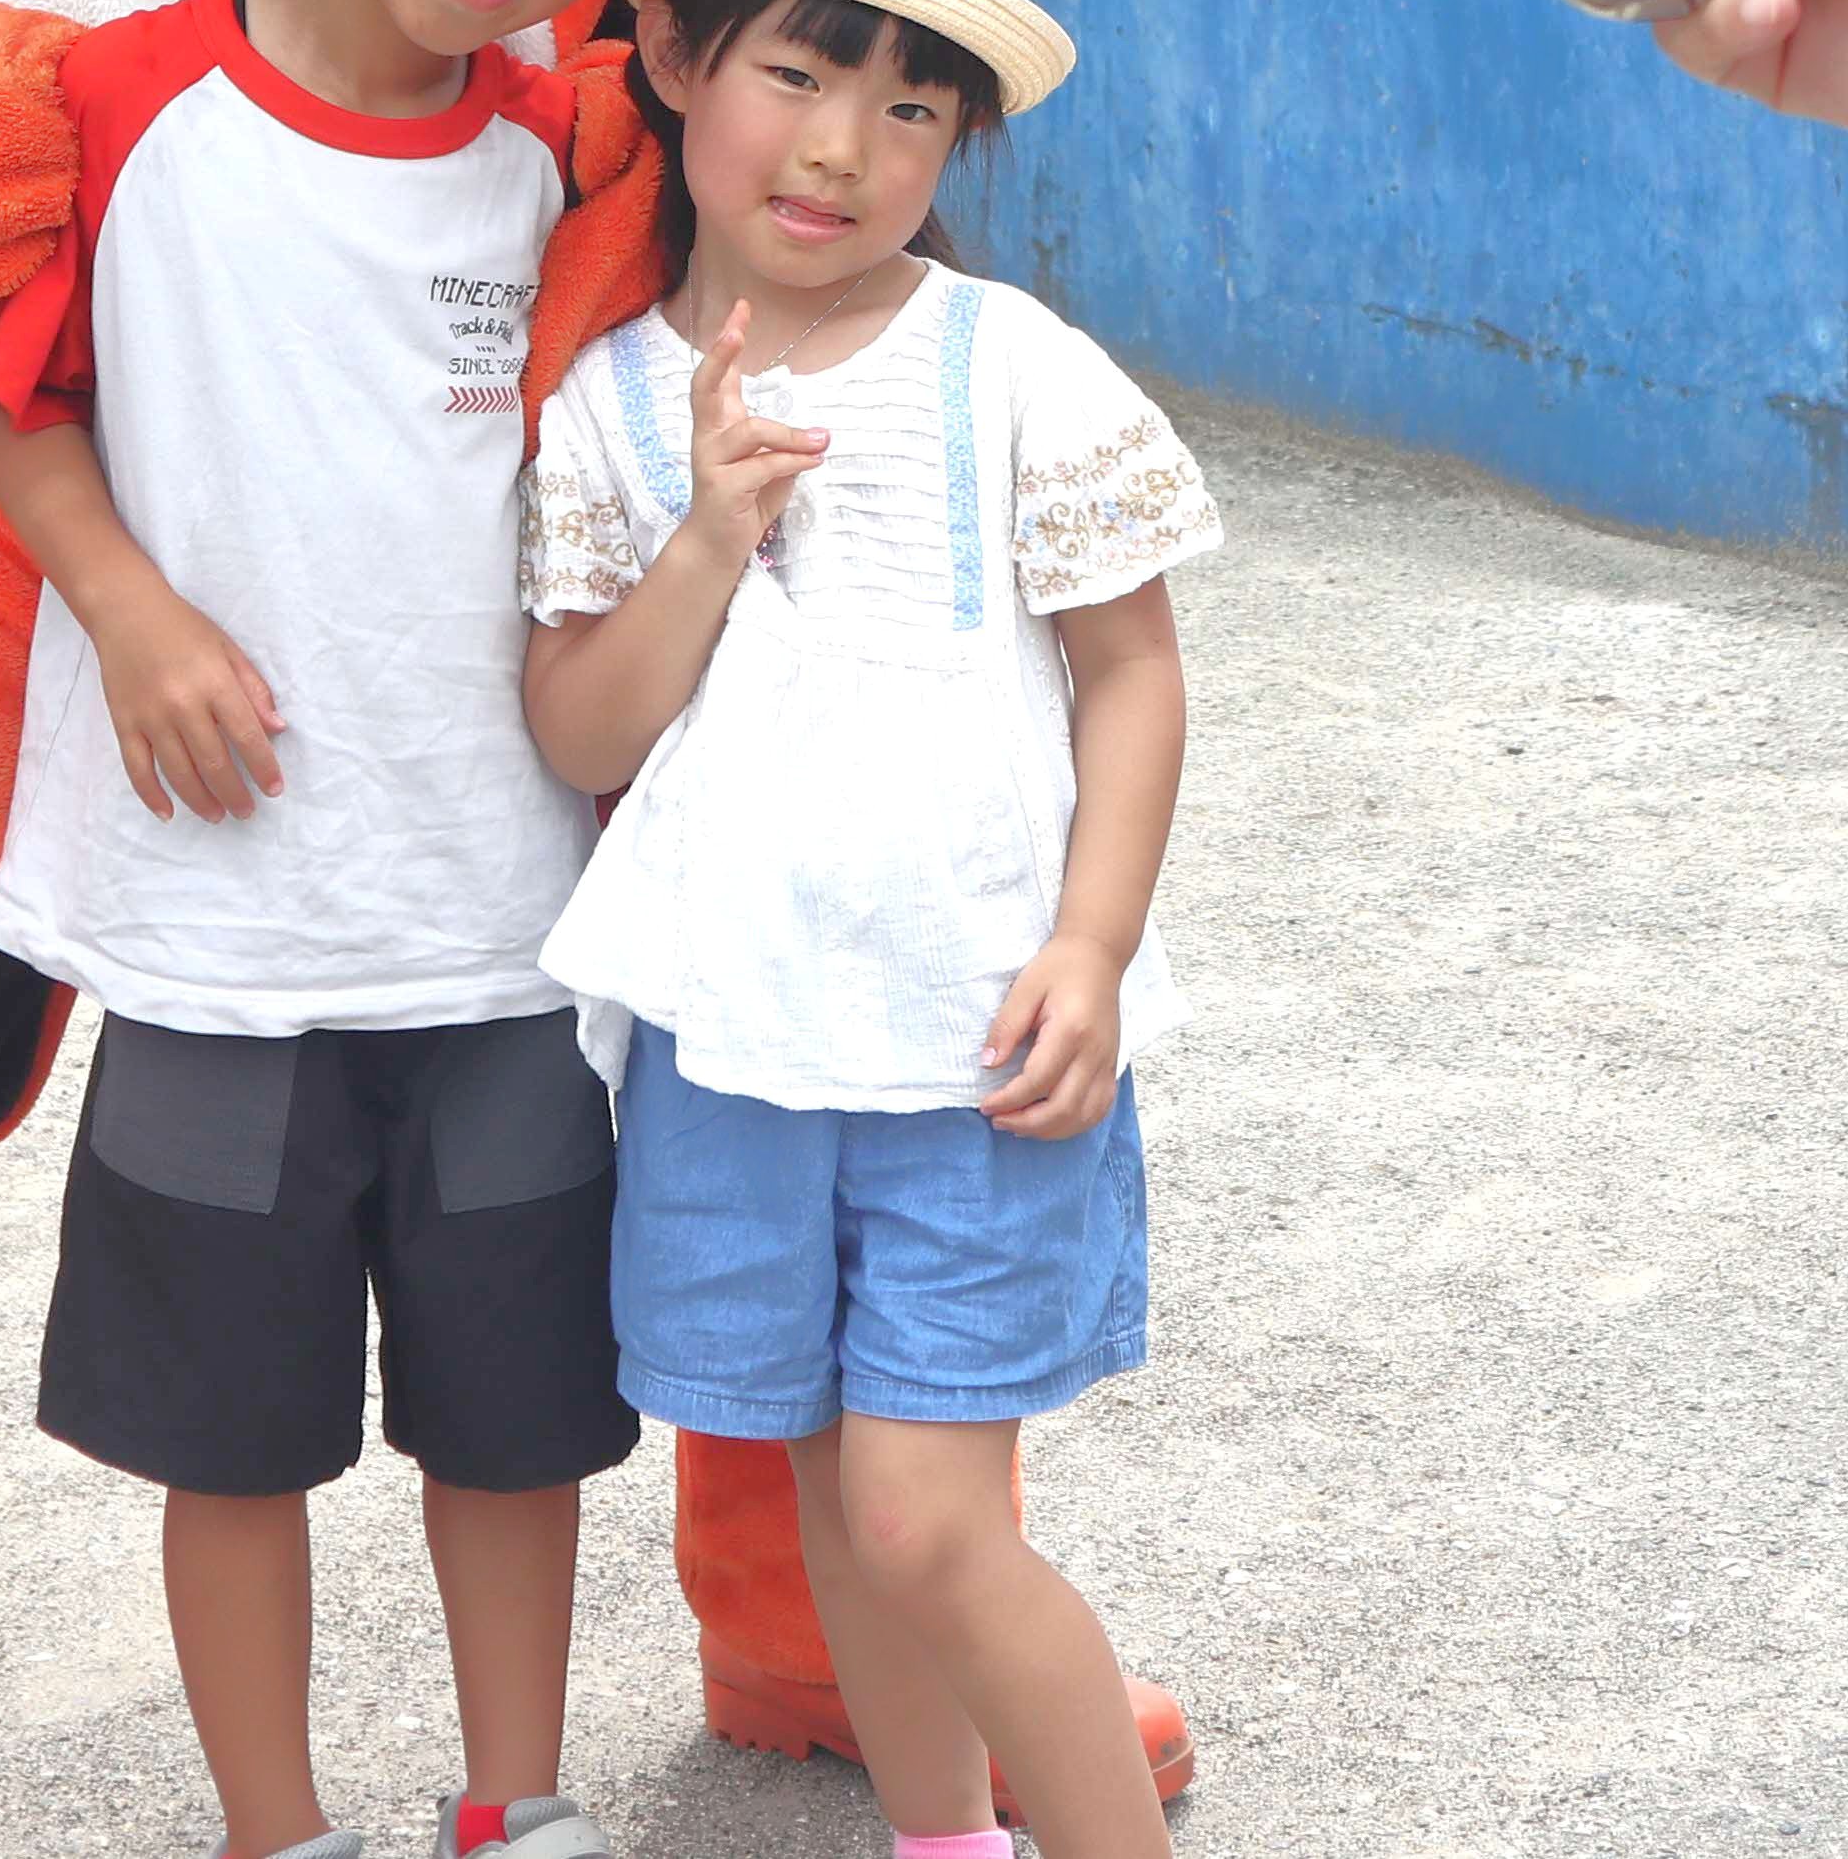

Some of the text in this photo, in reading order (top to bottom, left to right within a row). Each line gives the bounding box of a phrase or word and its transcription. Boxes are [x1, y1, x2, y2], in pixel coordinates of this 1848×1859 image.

[449, 316, 483, 340] Track
[484, 318, 495, 335] &
[448, 357, 495, 376] SINCE
